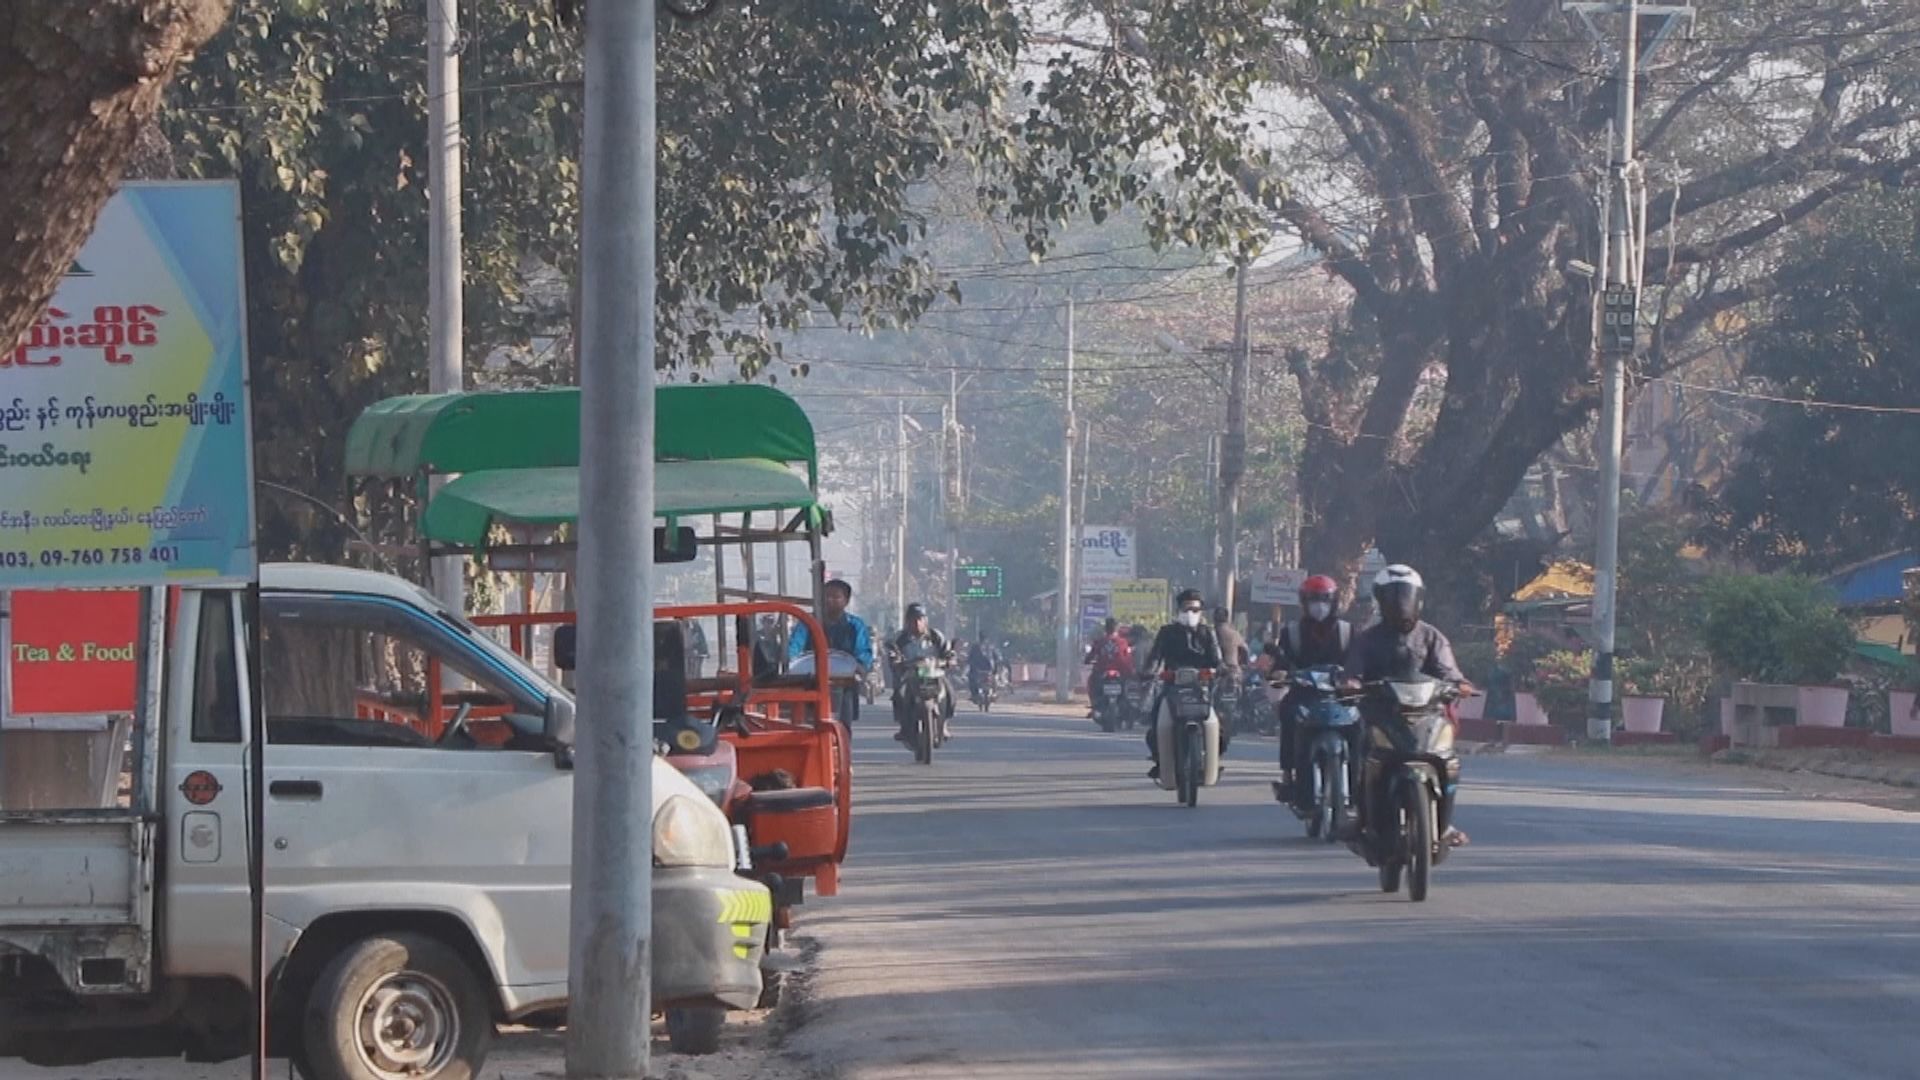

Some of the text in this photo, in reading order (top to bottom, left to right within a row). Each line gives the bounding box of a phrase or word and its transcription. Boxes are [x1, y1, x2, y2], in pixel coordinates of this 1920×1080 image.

[36, 396, 59, 430] နှင့်
[40, 548, 104, 567] 09-760
[110, 547, 143, 563] 758
[149, 545, 181, 562] 401
[13, 641, 136, 663] Tea & Food
